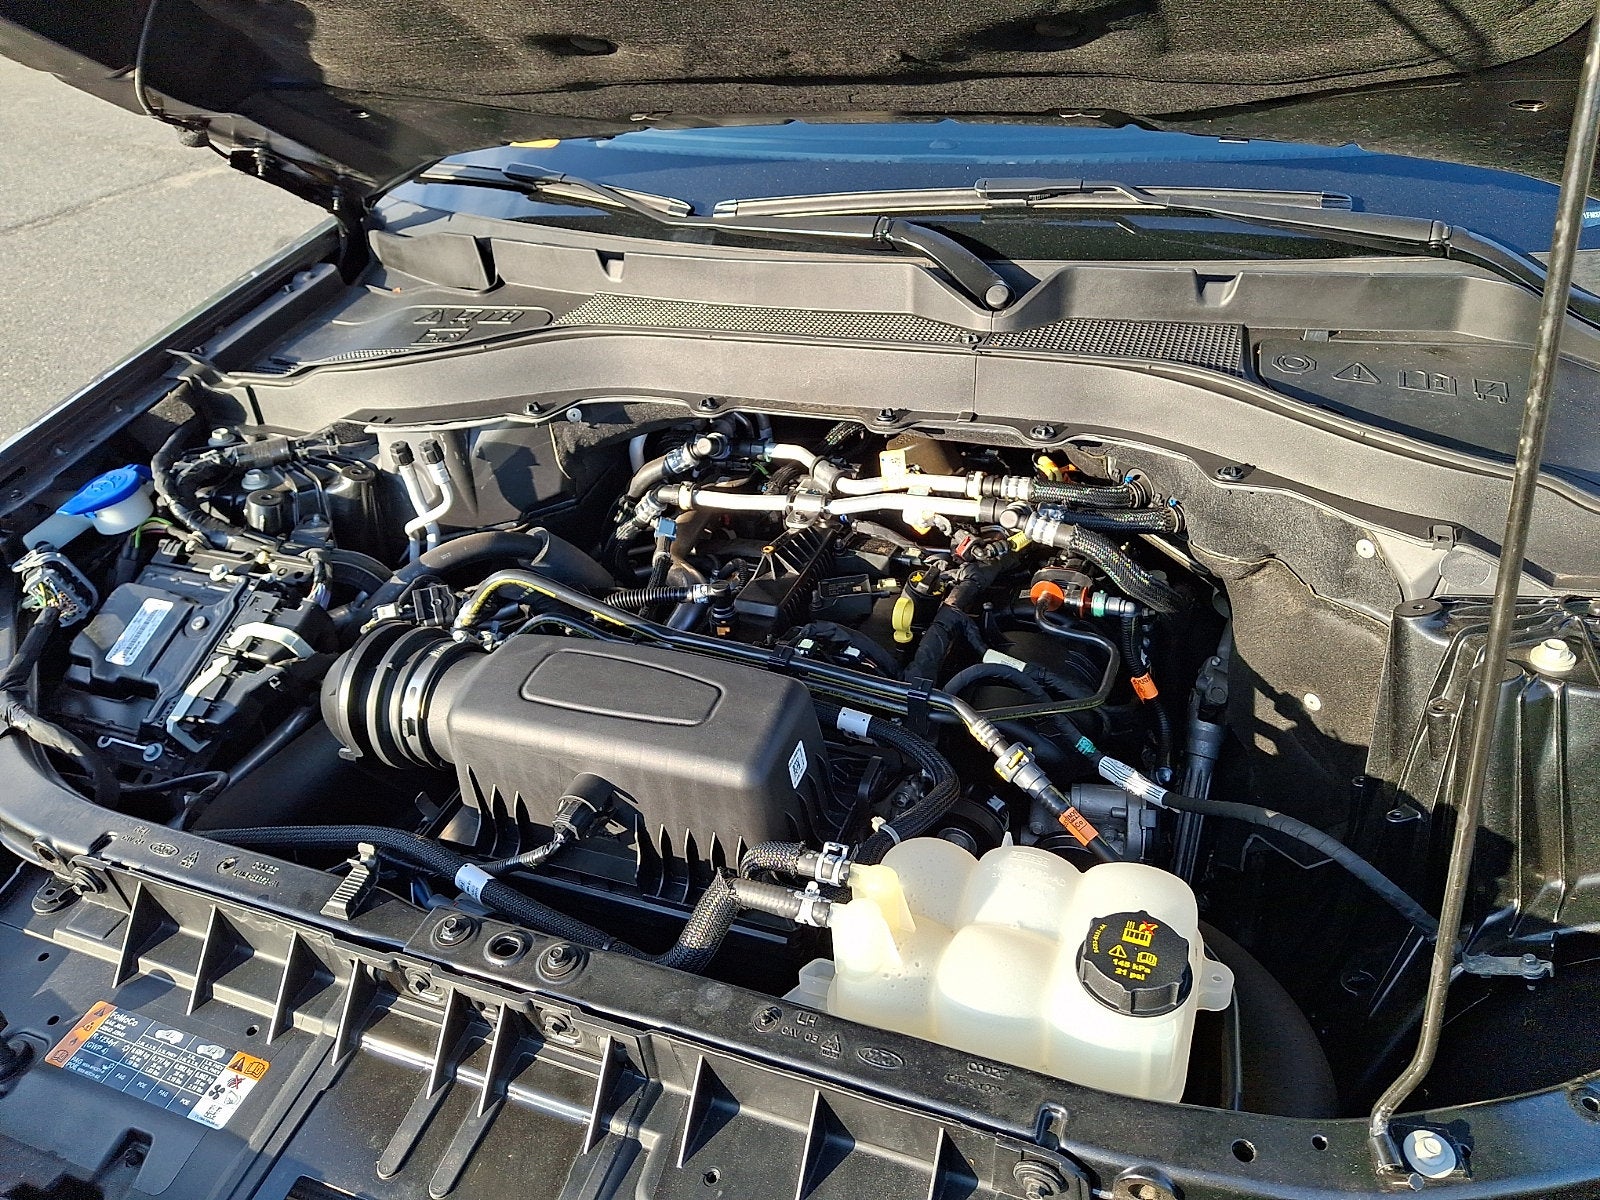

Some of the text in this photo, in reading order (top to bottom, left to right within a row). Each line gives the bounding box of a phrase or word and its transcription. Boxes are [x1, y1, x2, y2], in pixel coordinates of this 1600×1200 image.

[1112, 958, 1151, 974] 145 kPa
[1115, 967, 1145, 981] 21 psi
[110, 1011, 138, 1026] FoMoCo
[795, 1011, 819, 1028] LH
[92, 1033, 119, 1047] R-1234yf
[136, 1080, 147, 1088] POE
[157, 1088, 169, 1097] PAG
[178, 1097, 190, 1105] POE
